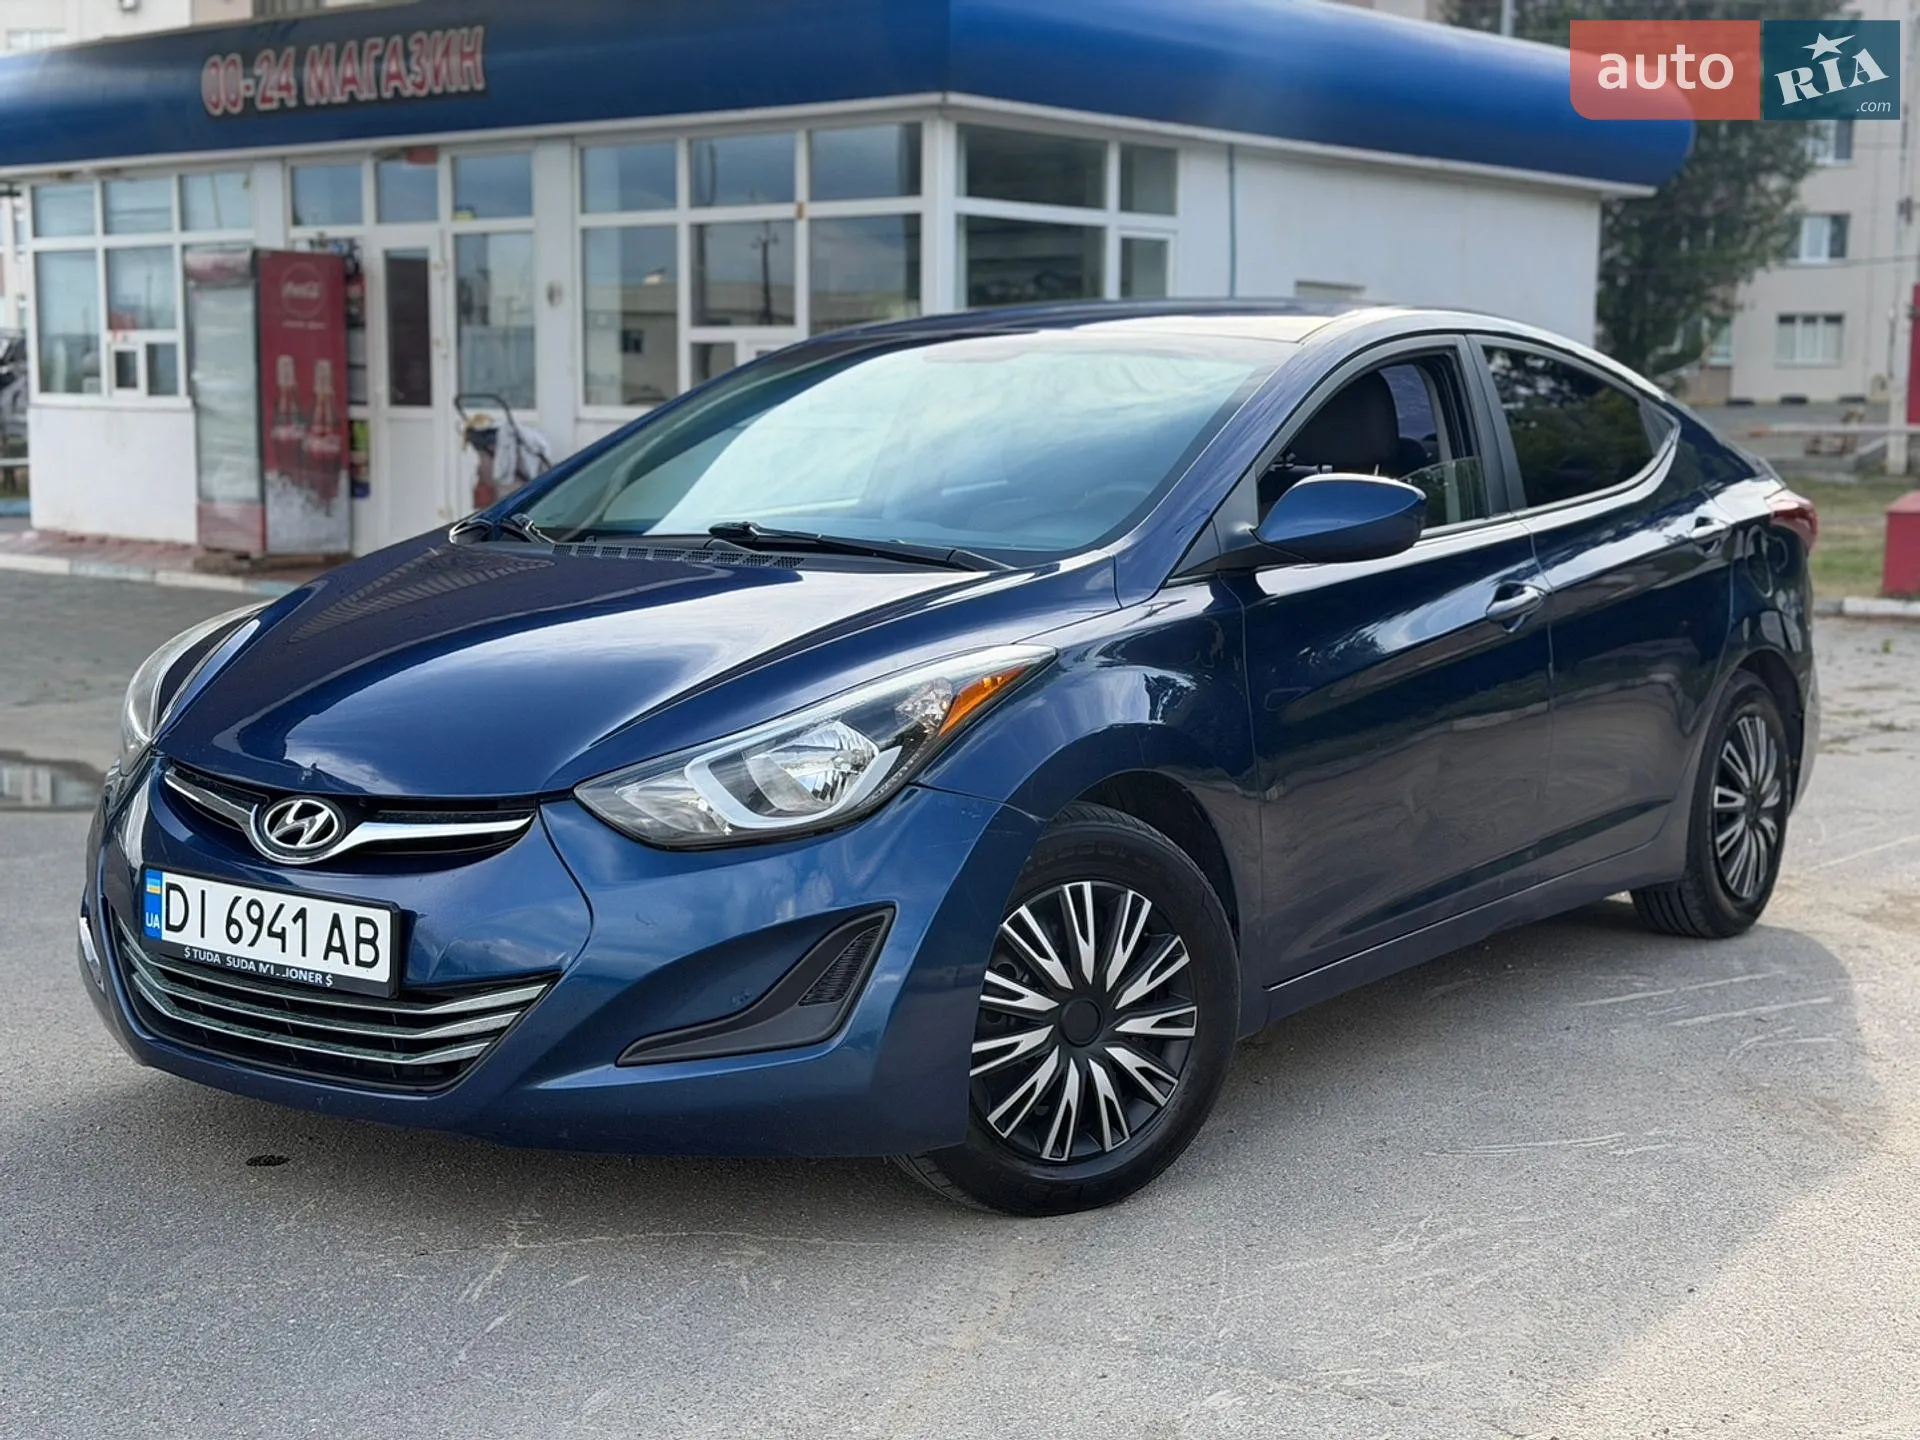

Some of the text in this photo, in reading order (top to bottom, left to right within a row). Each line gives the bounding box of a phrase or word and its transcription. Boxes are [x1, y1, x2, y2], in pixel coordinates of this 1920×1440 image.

[201, 25, 485, 115] 00-24 МАГАЗИН
[145, 913, 161, 929] UA
[164, 881, 380, 969] DI 6941 AB
[193, 949, 222, 964] TUDA
[226, 955, 257, 972] SUDA
[258, 962, 324, 985] MIIONER
